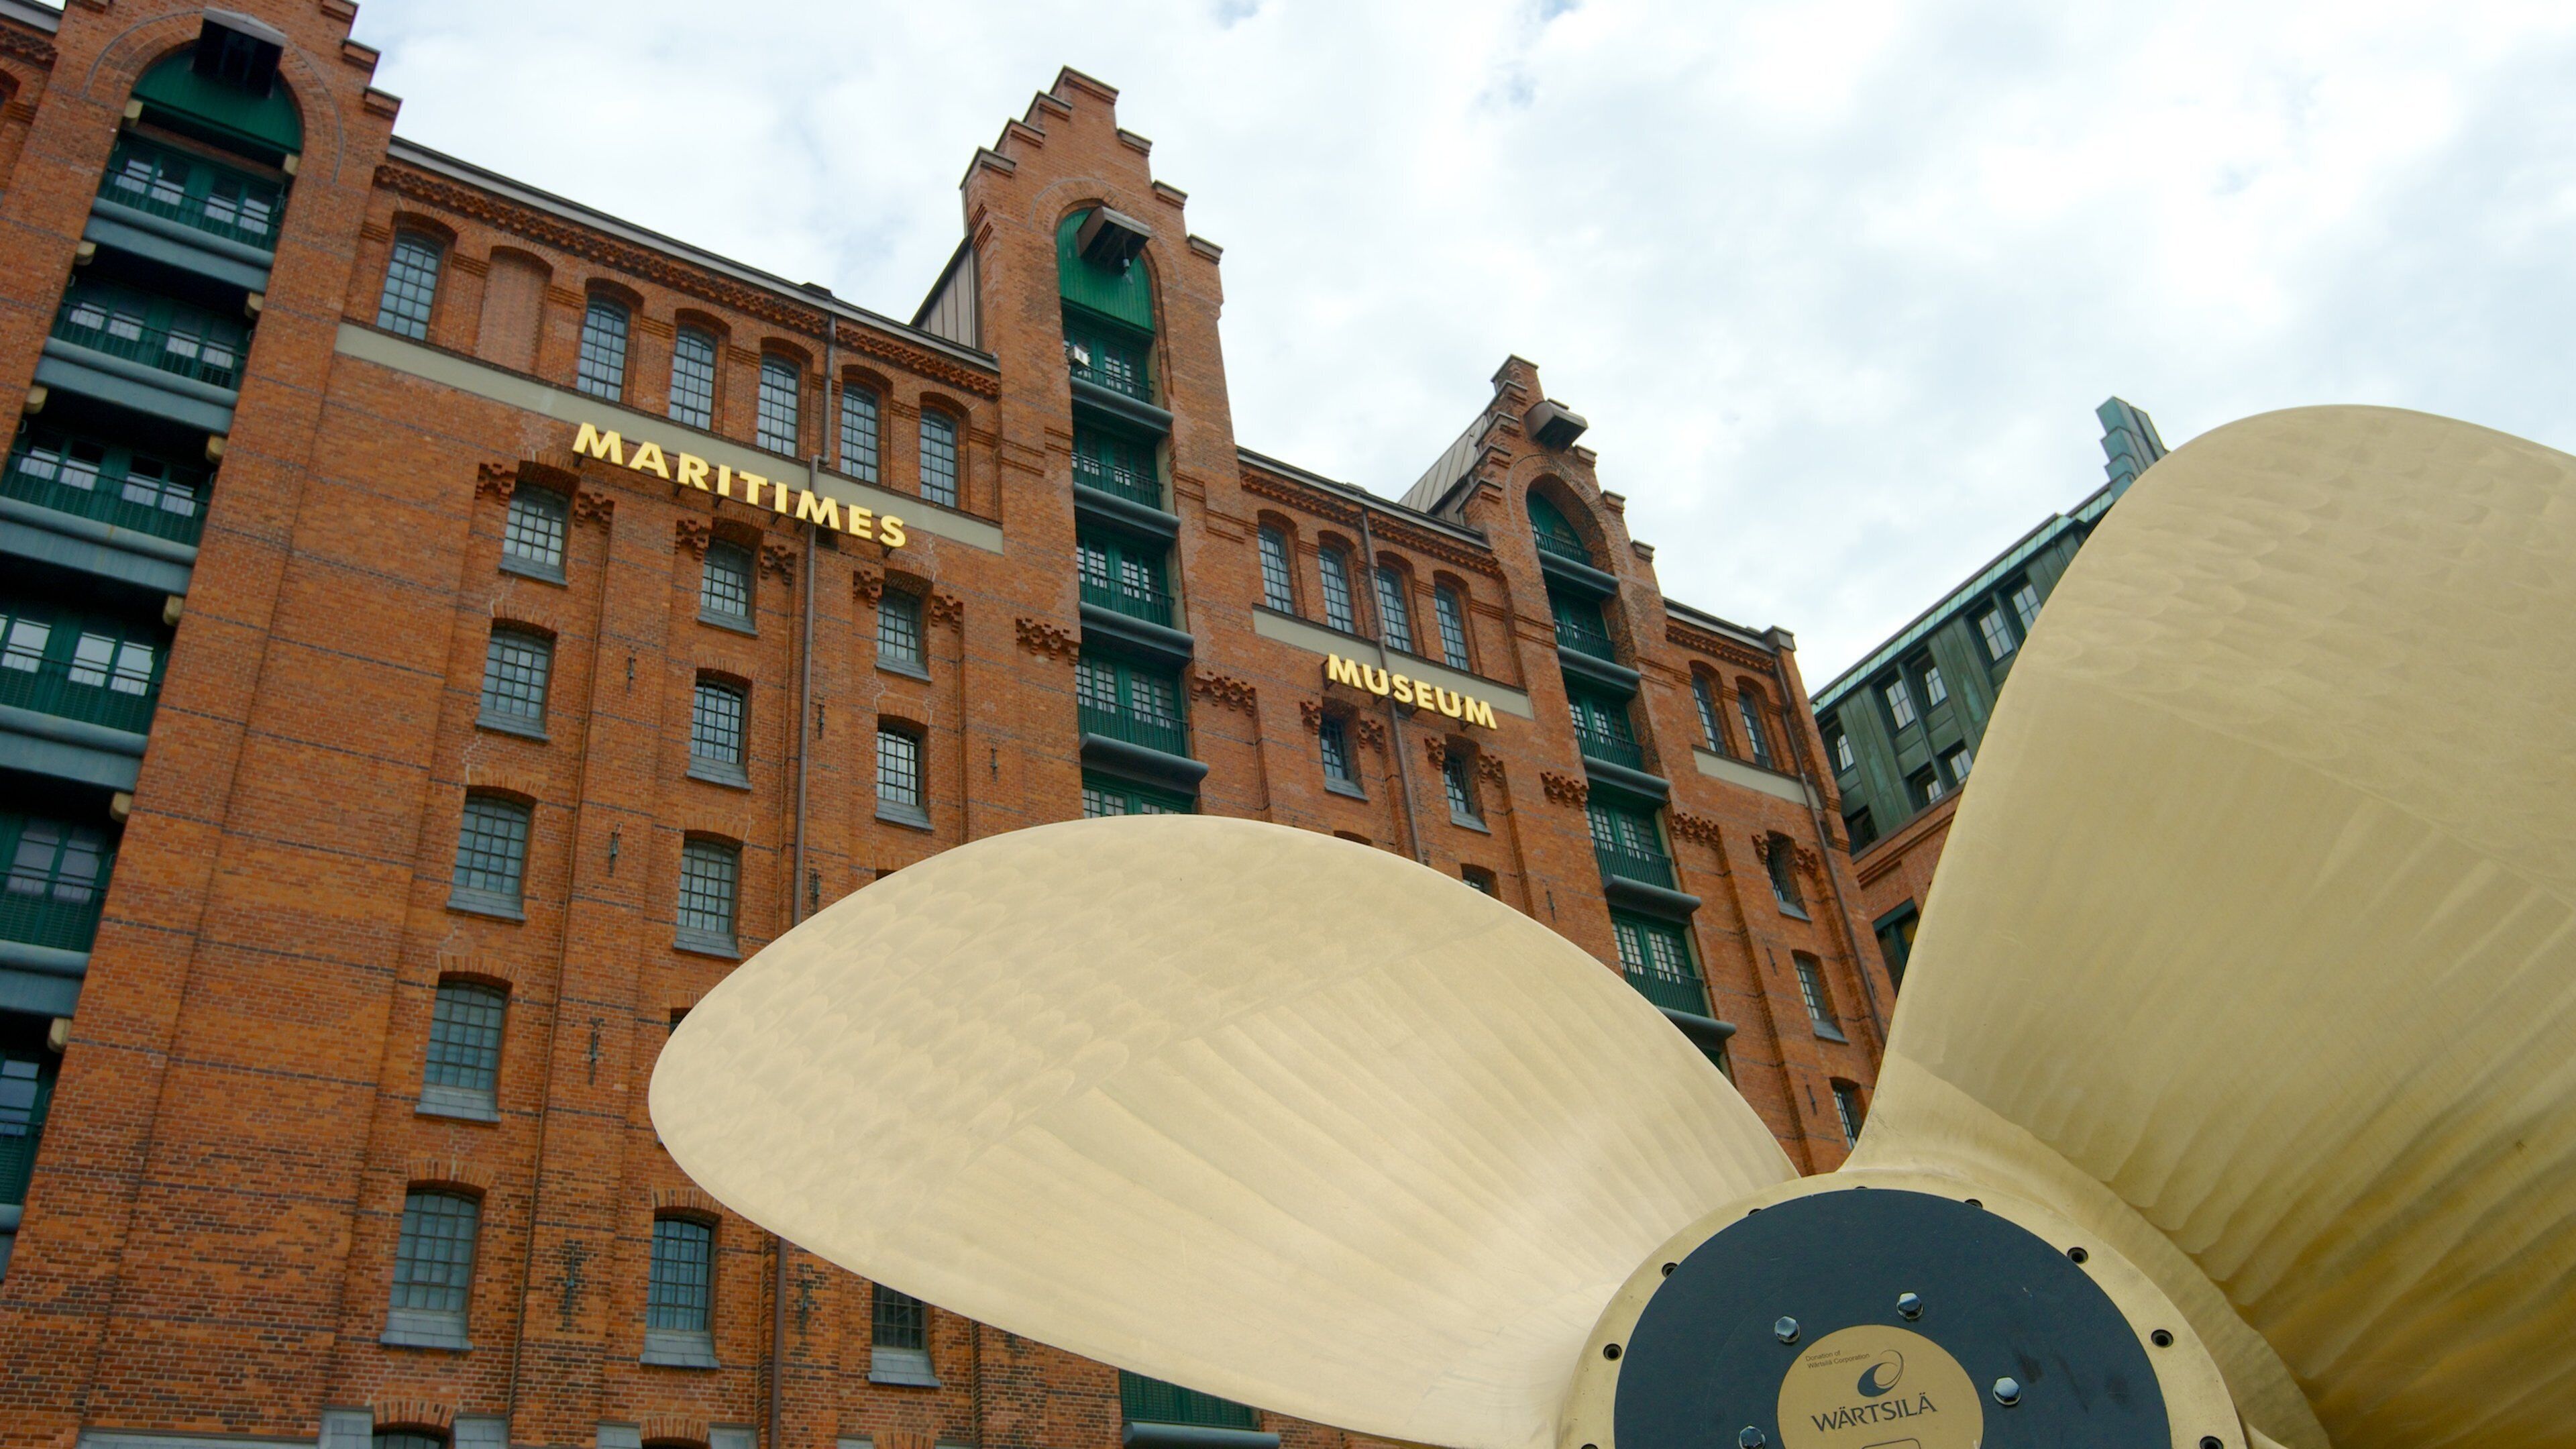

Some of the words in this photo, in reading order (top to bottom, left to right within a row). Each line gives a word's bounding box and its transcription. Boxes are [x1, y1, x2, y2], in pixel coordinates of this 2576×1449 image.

[573, 422, 906, 548] MARITIMES
[1328, 653, 1497, 729] MUSEUM
[1805, 1352, 1833, 1362] Donation
[1807, 1359, 1833, 1368] Wärtsilä
[1833, 1353, 1870, 1364] Corporation
[1811, 1392, 1937, 1432] WÄRTSILÄ
